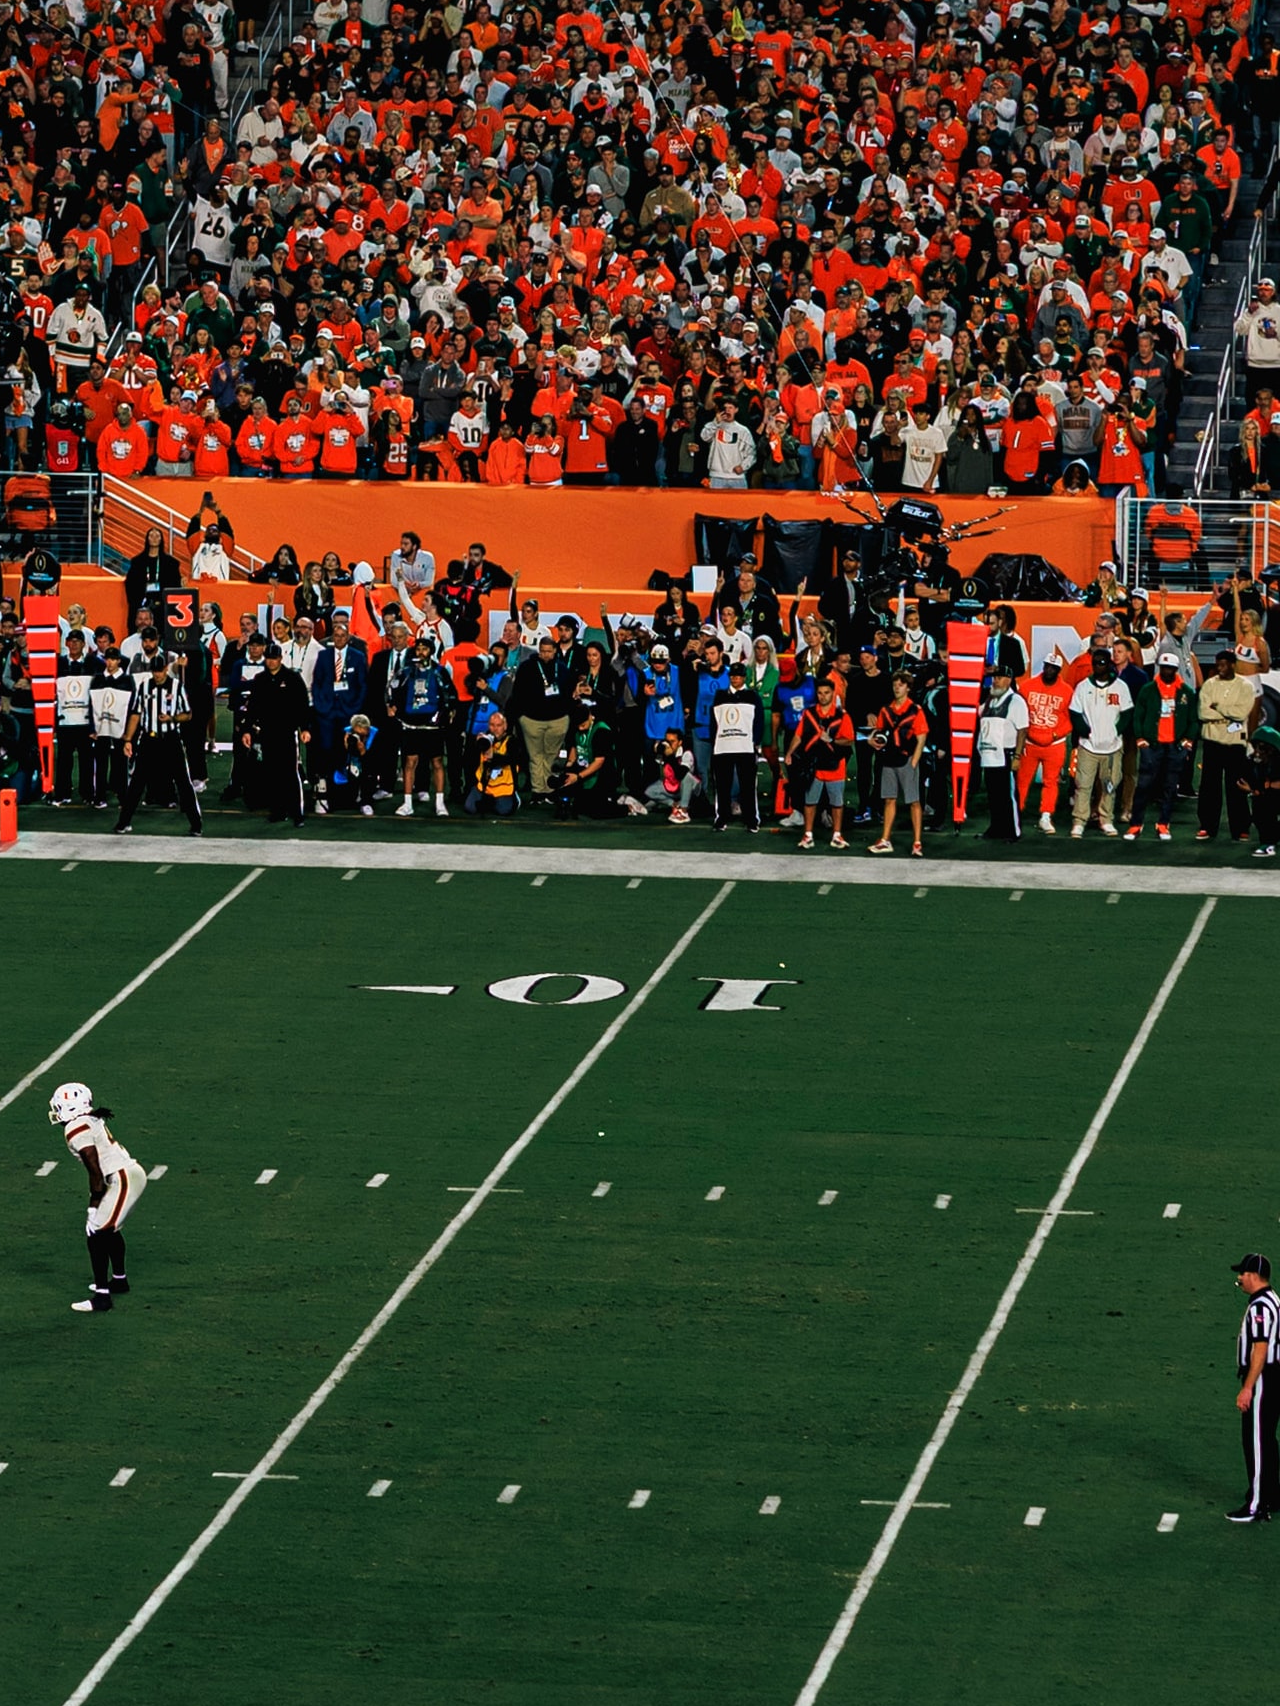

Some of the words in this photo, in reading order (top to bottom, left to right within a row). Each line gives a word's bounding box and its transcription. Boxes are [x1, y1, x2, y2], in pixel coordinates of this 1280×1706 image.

[201, 219, 225, 239] 26
[11, 259, 25, 277] 5
[462, 427, 482, 443] 10
[579, 420, 589, 440] 1
[1012, 431, 1020, 448] 1
[167, 593, 195, 628] 3
